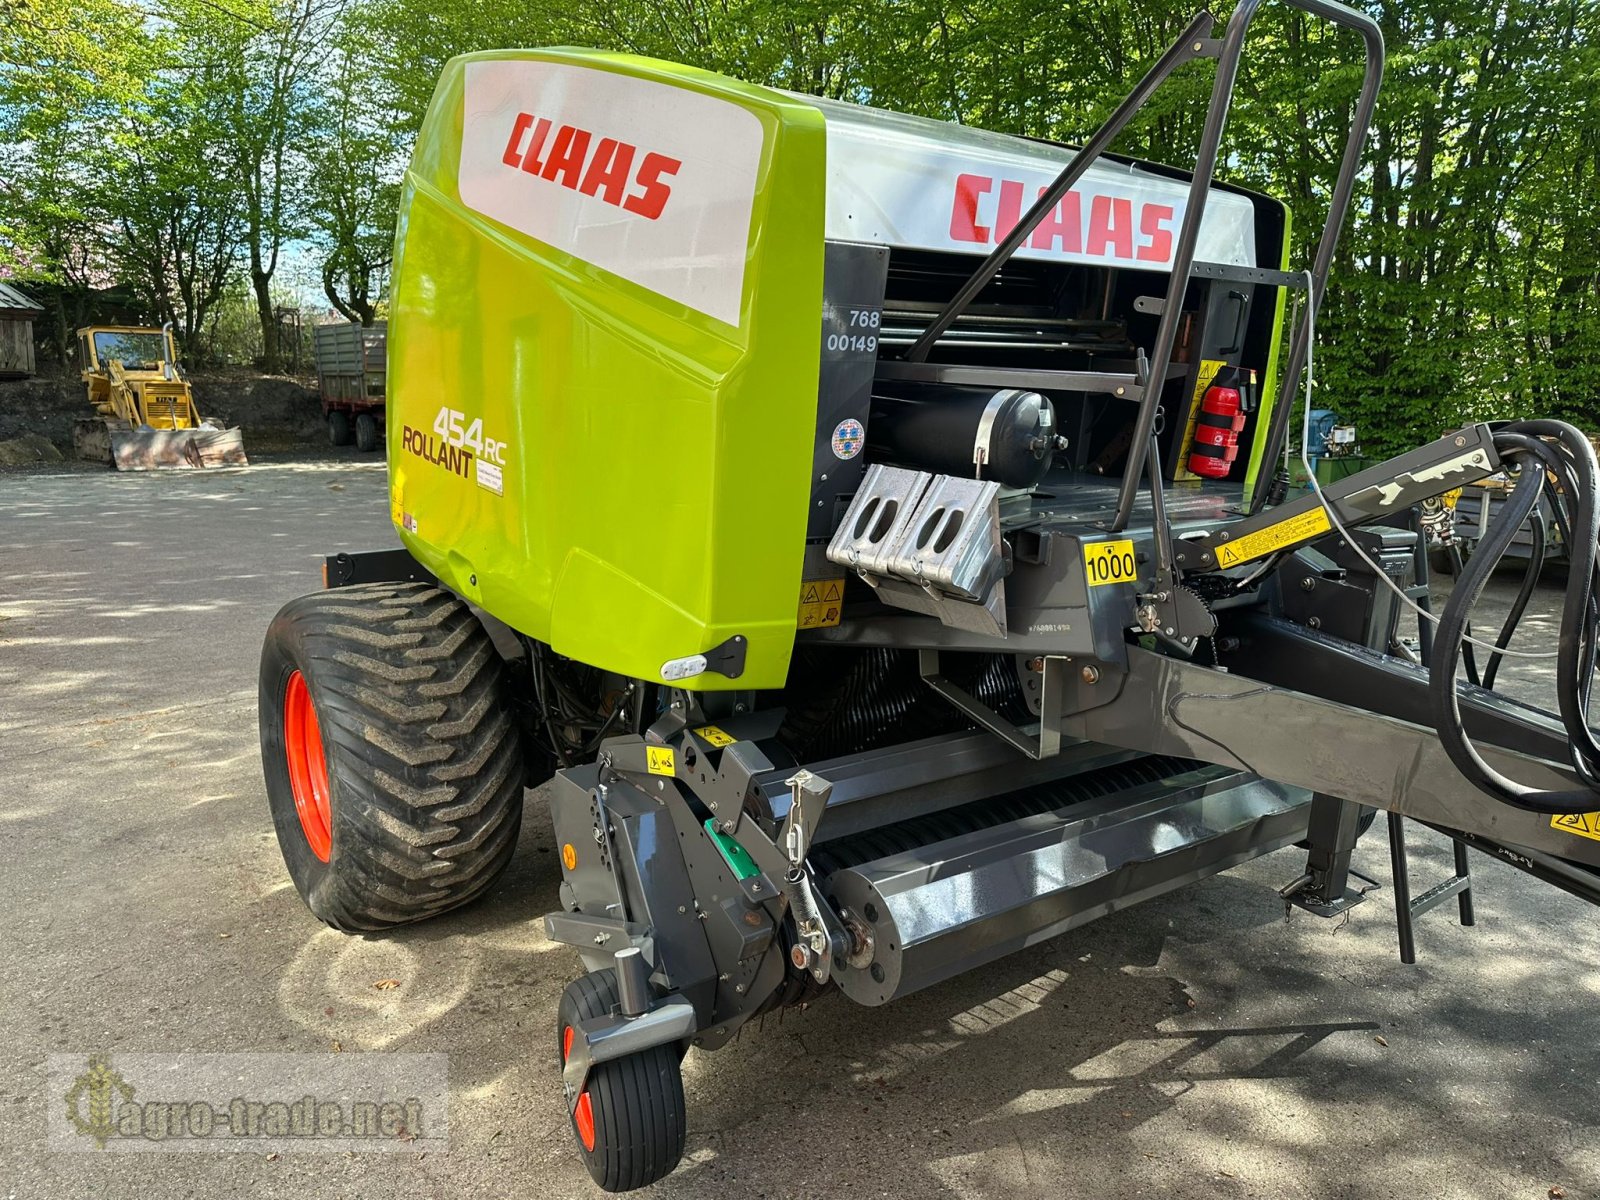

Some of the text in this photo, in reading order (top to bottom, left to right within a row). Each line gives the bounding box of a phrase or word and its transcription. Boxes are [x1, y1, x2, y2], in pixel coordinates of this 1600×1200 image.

[502, 112, 682, 220] CLAAS
[950, 174, 1174, 264] CLAAS
[827, 333, 877, 353] 00149
[850, 310, 880, 329] 768
[402, 425, 473, 478] ROLLANT
[433, 406, 507, 465] 454 RC
[1087, 552, 1135, 582] 1000
